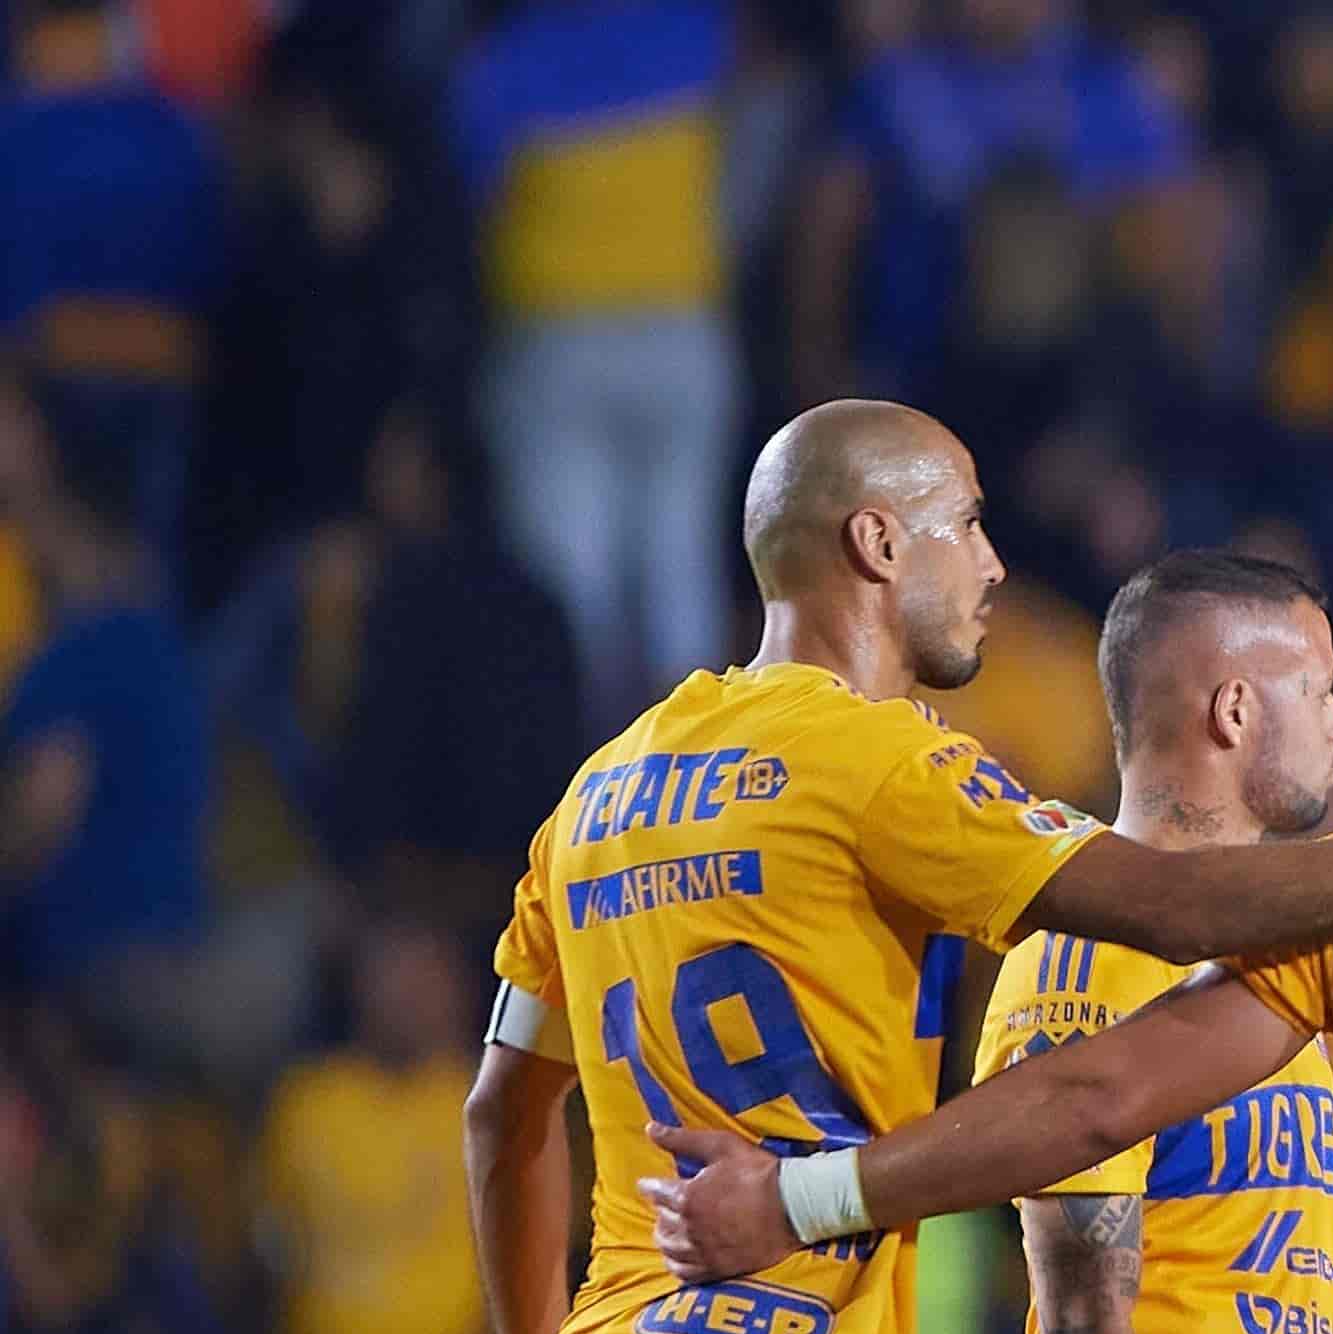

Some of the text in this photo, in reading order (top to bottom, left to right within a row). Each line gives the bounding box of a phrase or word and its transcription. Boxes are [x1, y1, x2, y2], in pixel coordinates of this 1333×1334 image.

[572, 747, 788, 846] TECATE 18+
[618, 852, 743, 913] AFIRME
[602, 942, 877, 1180] 19
